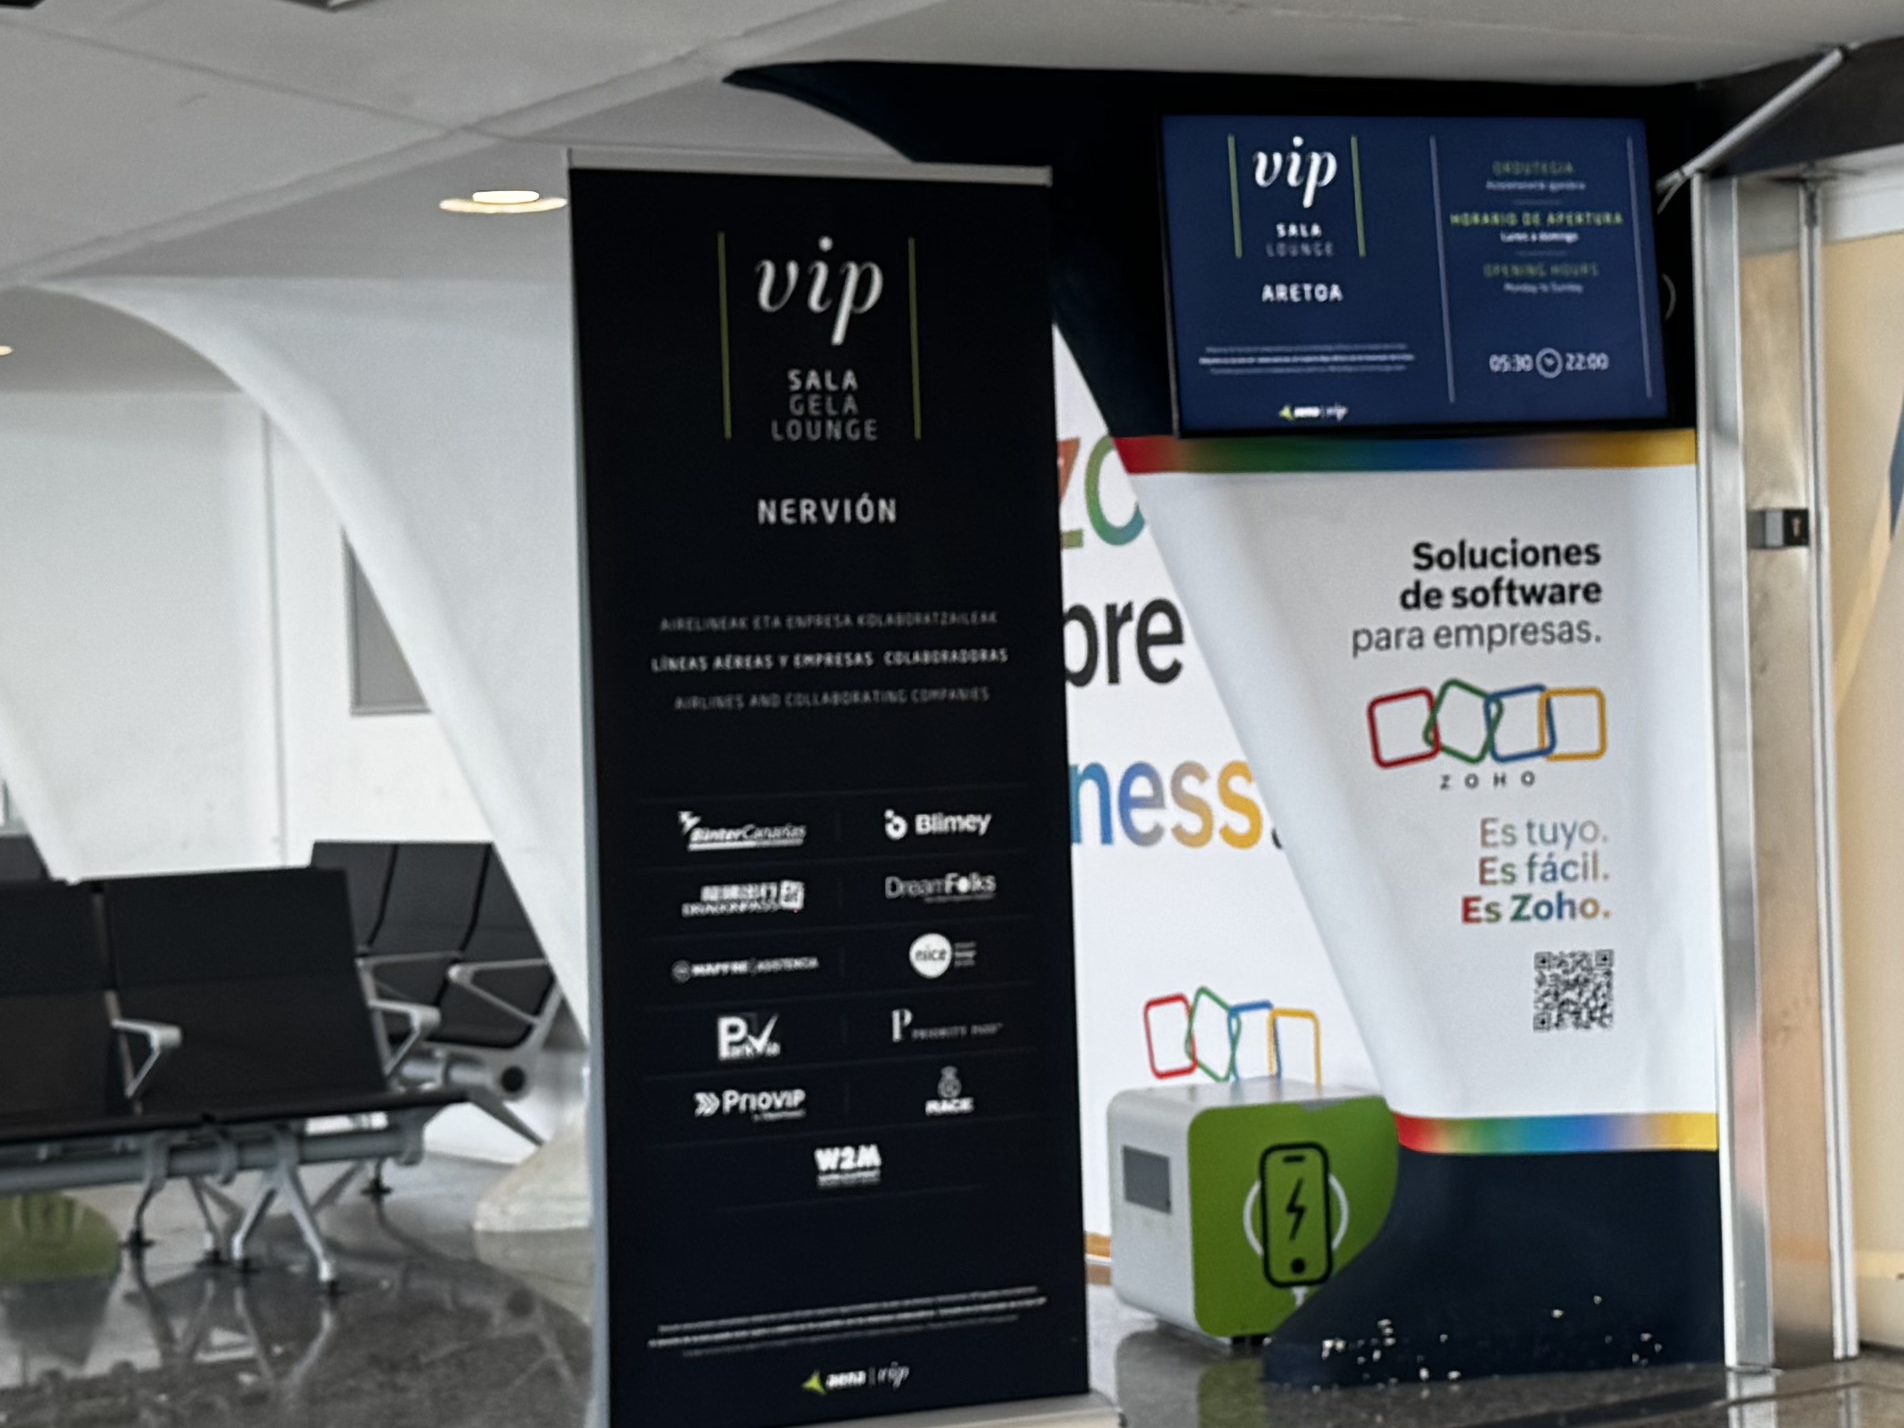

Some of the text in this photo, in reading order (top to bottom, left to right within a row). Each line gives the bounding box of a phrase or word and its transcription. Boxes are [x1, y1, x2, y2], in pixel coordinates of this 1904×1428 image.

[1255, 136, 1337, 208] vip
[1276, 223, 1322, 238] SALA
[759, 236, 883, 345] vip
[1565, 352, 1609, 371] 22:00
[788, 369, 858, 391] SALA
[789, 393, 858, 416] GELA
[771, 418, 877, 441] LOUNGE
[758, 492, 896, 525] NERVIÓN
[1412, 537, 1602, 571] Soluciones
[1399, 576, 1602, 611] de software
[1352, 619, 1601, 658] para empresas.
[1439, 770, 1536, 791] ZOHO
[915, 813, 991, 835] Blimey
[1480, 817, 1610, 852] Es tuyo.
[1479, 850, 1609, 886] Es fácil.
[1461, 890, 1610, 924] Es Zoho.
[814, 1145, 881, 1171] W2M
